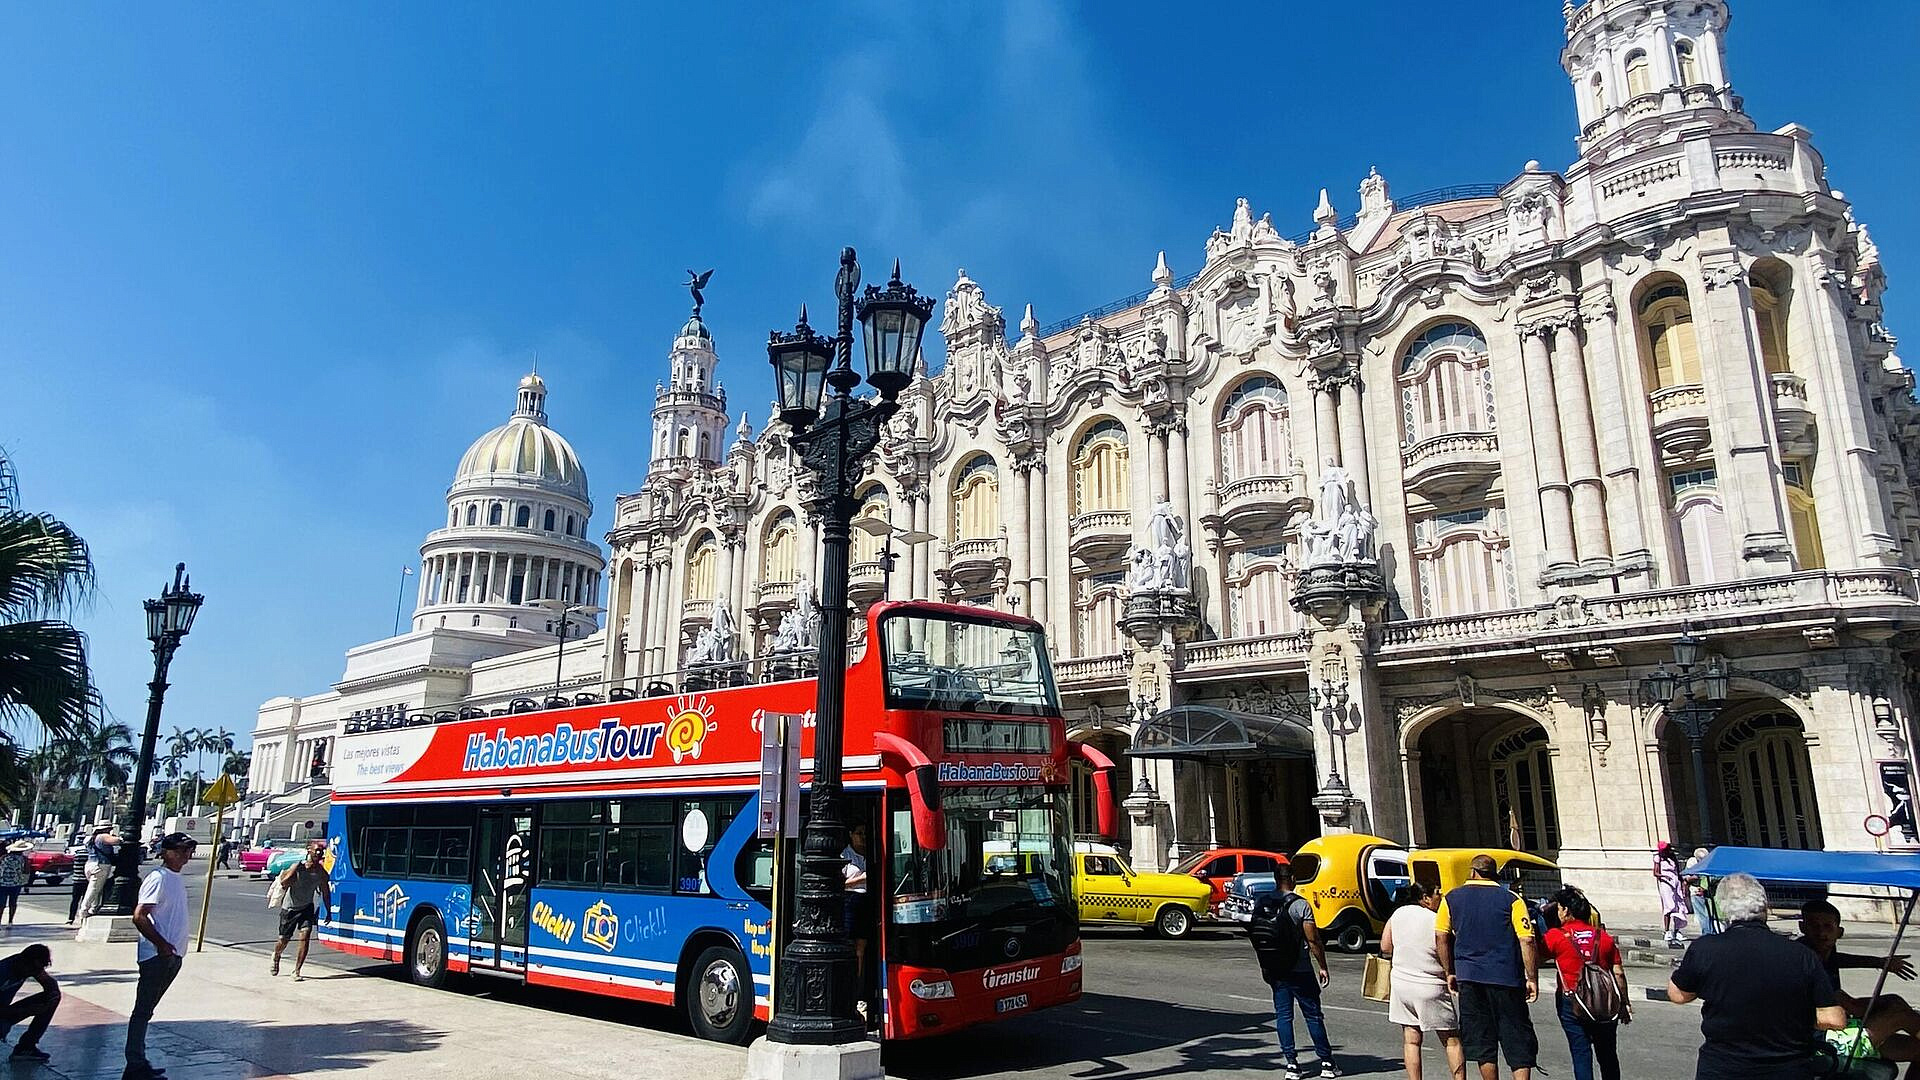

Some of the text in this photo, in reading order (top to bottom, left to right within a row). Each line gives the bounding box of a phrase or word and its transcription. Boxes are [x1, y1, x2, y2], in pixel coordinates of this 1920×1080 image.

[343, 745, 400, 760] Las mejores vistas
[463, 718, 664, 771] HabanaBusTour
[357, 763, 404, 776] The best views
[938, 761, 1040, 781] HabanaBusTour
[531, 901, 576, 944] Click!!
[624, 906, 667, 942] Click!!
